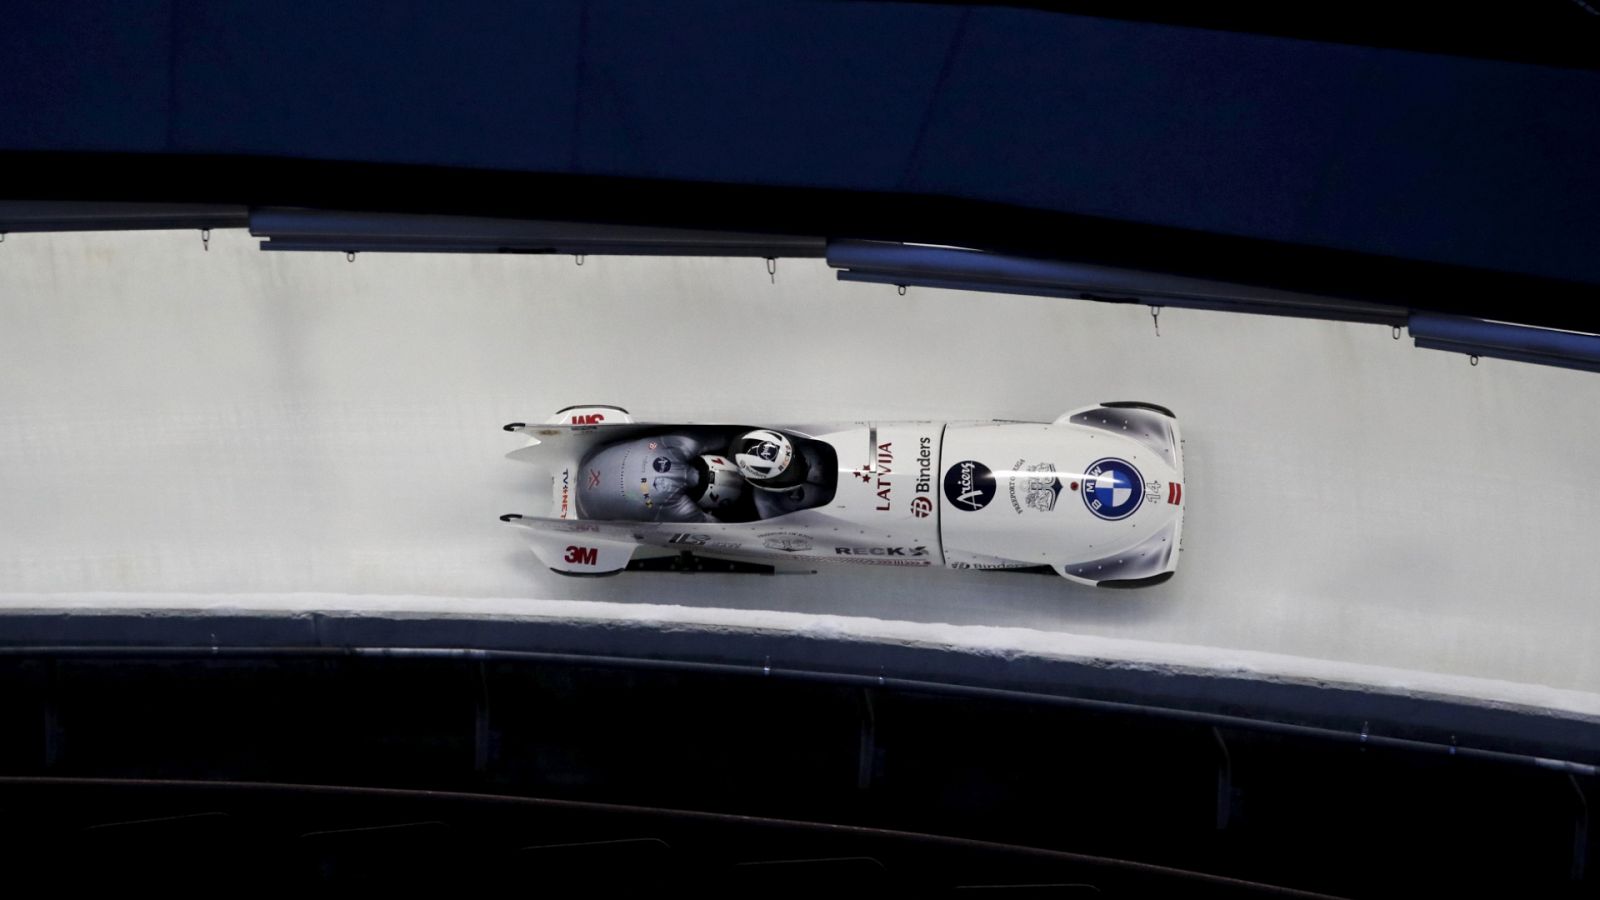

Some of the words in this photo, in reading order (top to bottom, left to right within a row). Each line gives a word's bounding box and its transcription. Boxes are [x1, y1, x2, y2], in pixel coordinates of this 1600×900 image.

[876, 442, 893, 511] LATVIJA
[915, 436, 931, 494] Binders
[1085, 466, 1103, 510] BMW
[1145, 480, 1161, 503] 14
[564, 545, 599, 566] 3M
